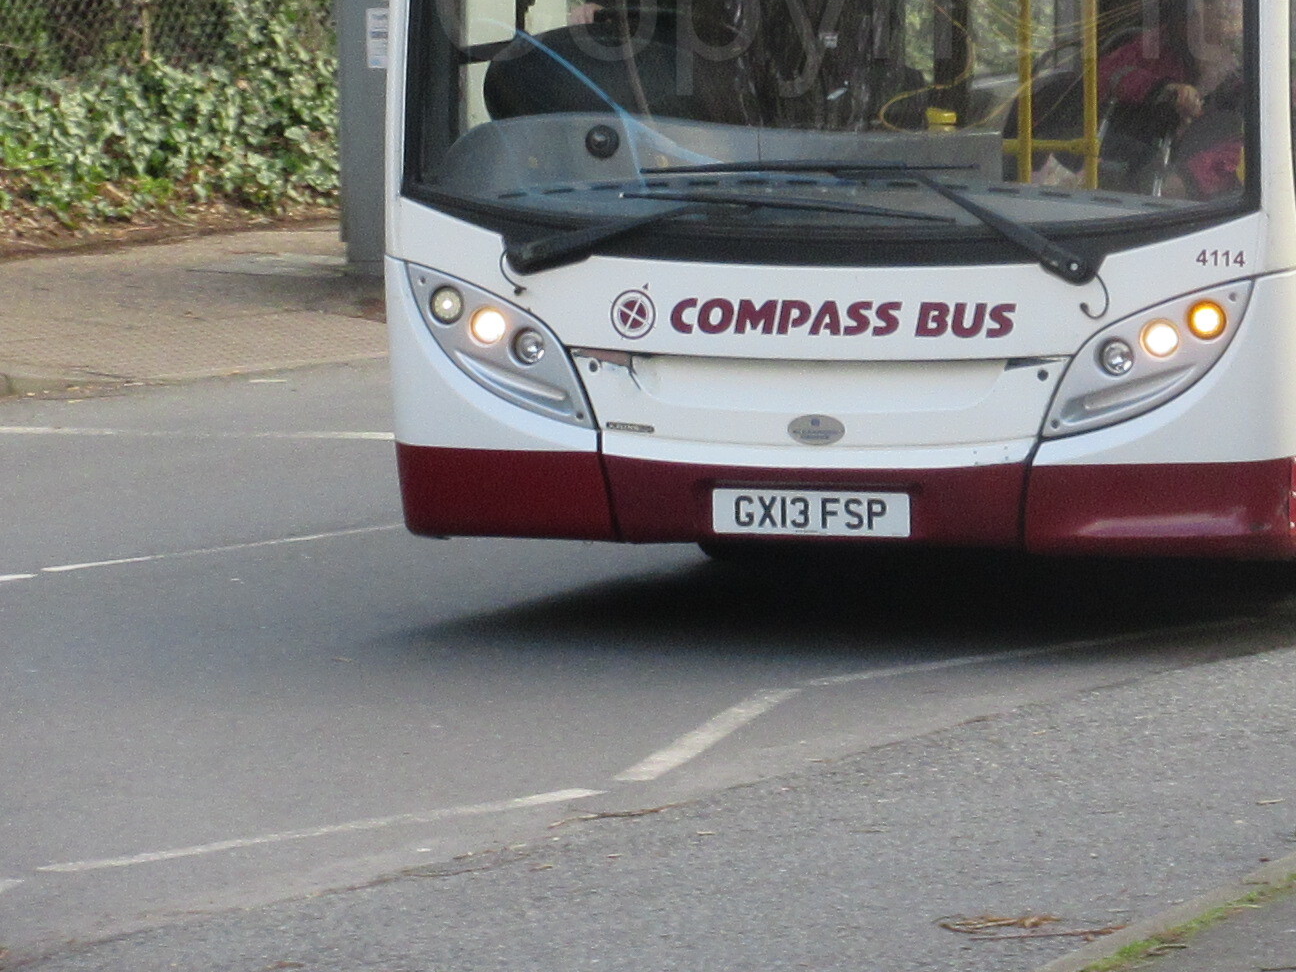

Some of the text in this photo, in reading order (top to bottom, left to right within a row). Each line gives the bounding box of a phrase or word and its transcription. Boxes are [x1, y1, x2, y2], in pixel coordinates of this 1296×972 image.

[1195, 249, 1246, 268] 4114
[669, 297, 1018, 339] COMPASS BUS
[734, 494, 888, 531] GX13 FSP
